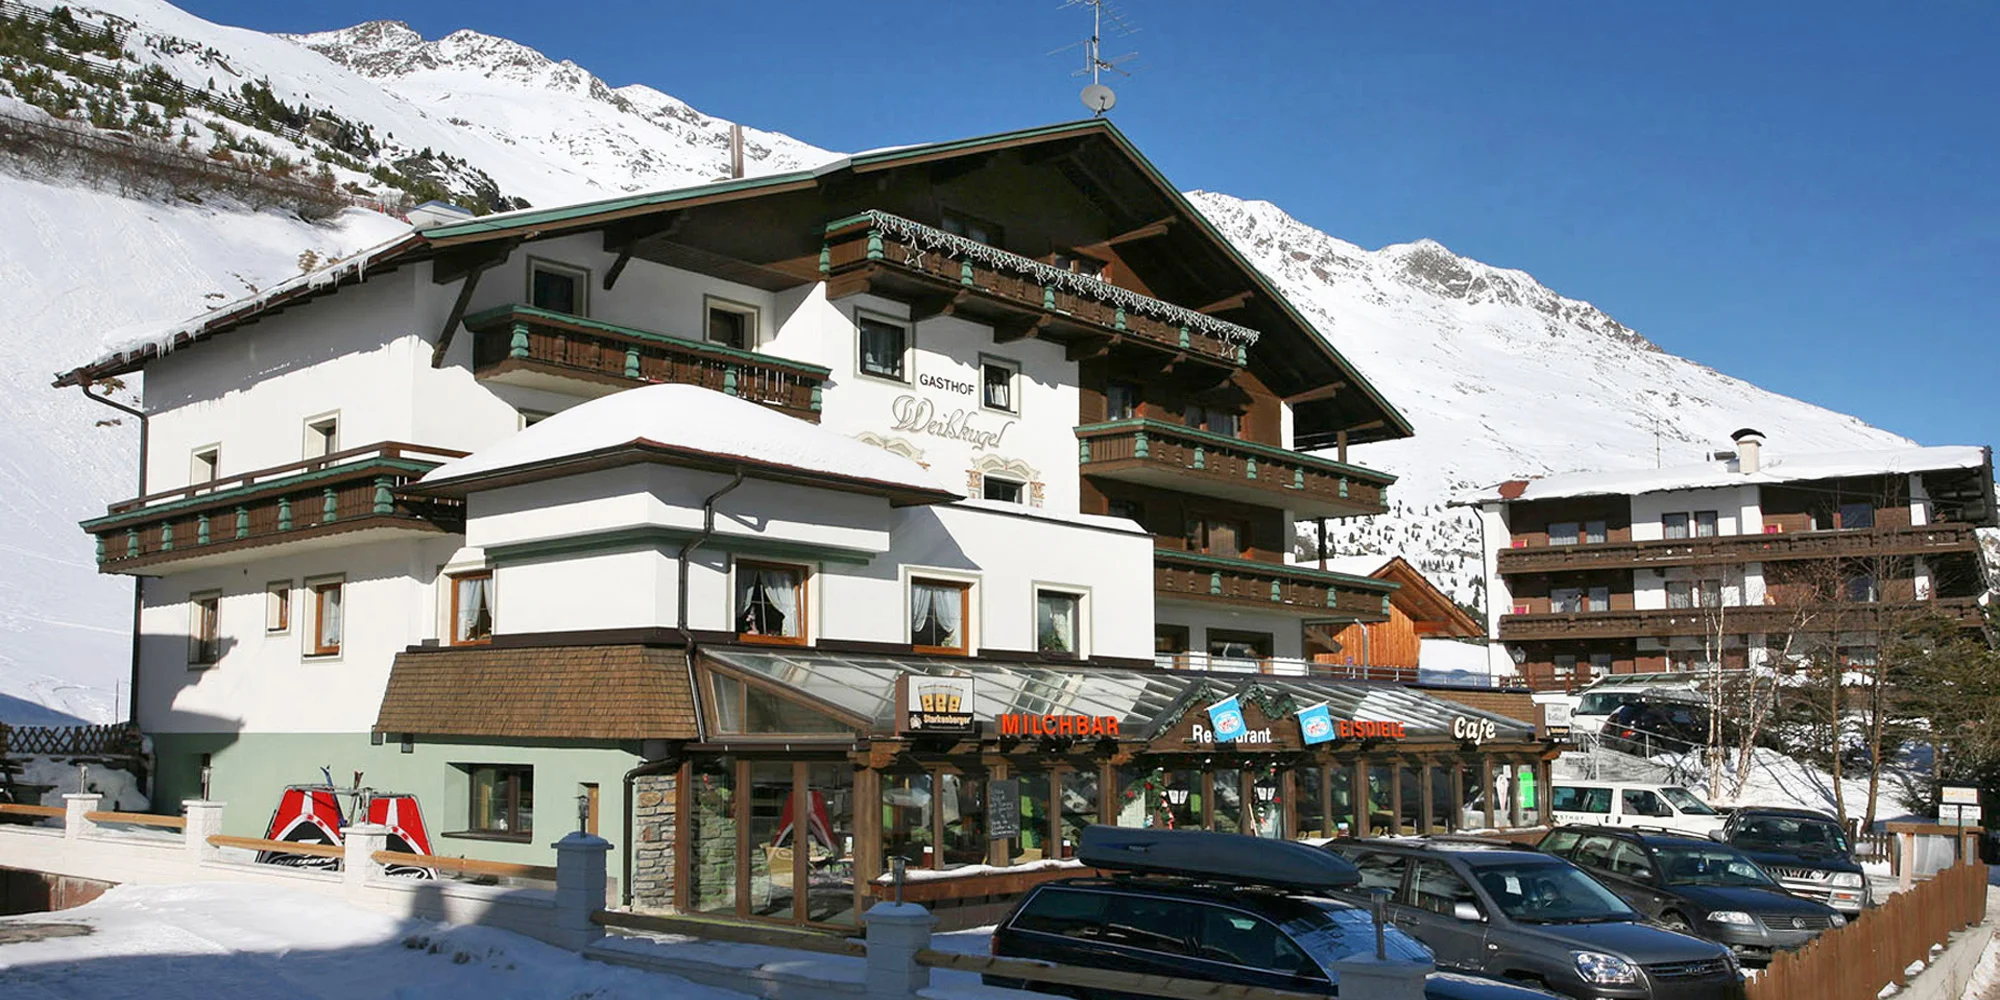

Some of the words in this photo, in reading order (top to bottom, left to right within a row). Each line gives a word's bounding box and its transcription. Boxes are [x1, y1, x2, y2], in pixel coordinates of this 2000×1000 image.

[919, 373, 975, 396] GASTHOF
[1001, 713, 1119, 735] MILCHBAR
[1192, 723, 1272, 744] Reurant
[1340, 720, 1407, 738] EISDIELE
[1454, 716, 1496, 745] Cafe
